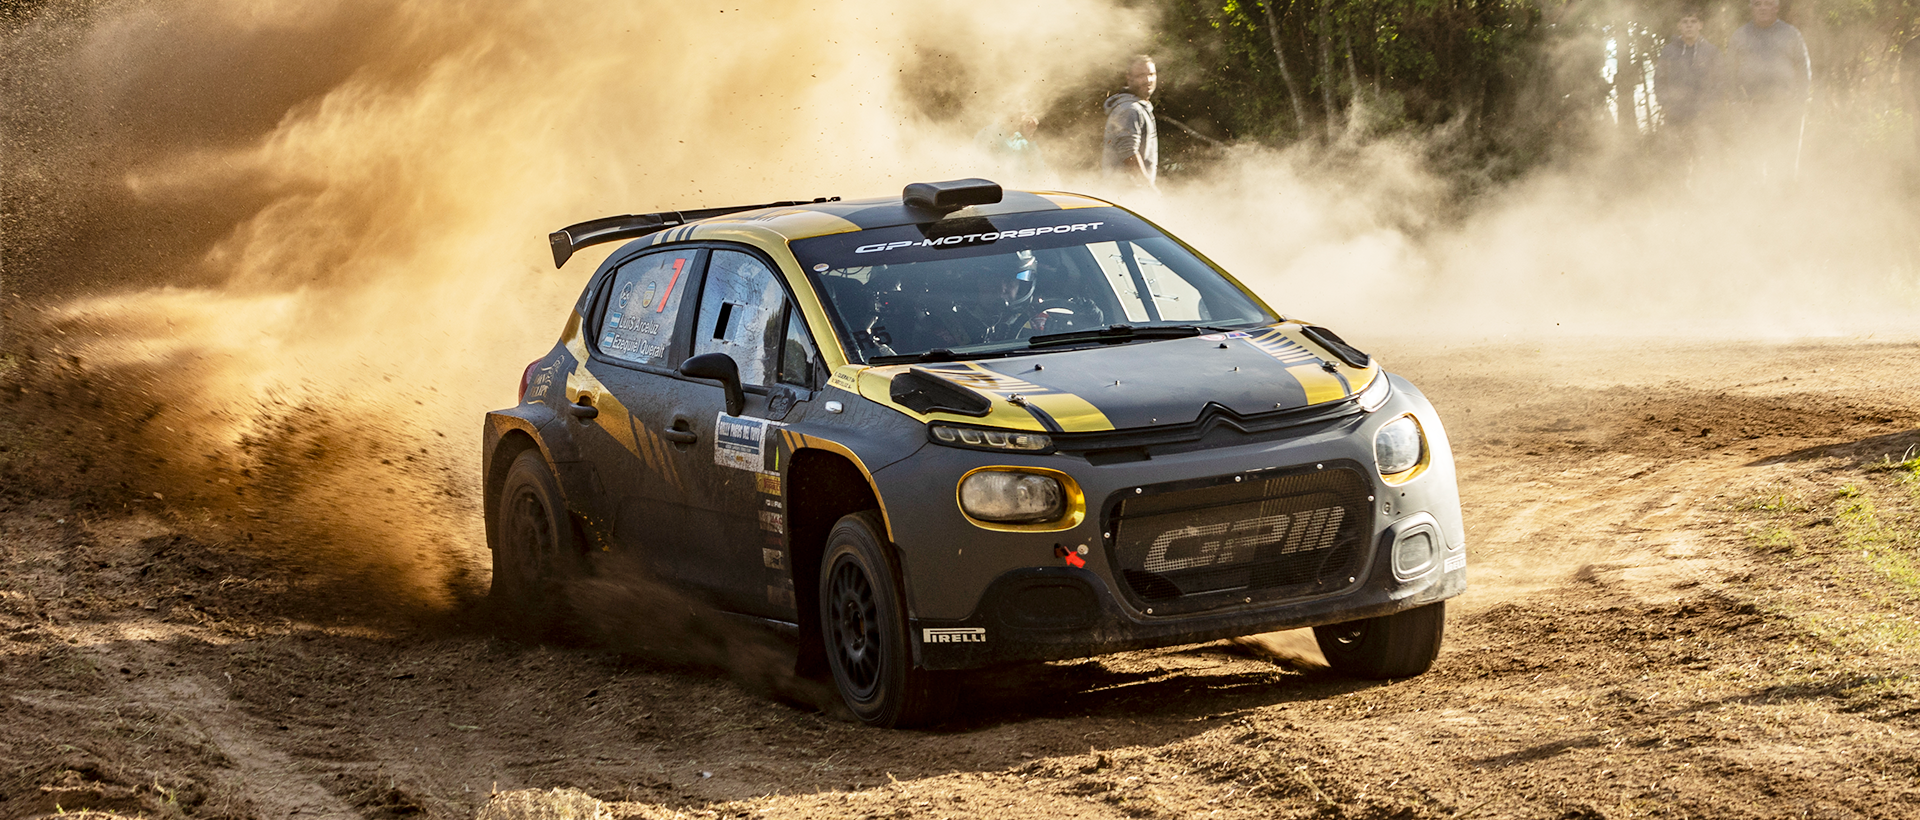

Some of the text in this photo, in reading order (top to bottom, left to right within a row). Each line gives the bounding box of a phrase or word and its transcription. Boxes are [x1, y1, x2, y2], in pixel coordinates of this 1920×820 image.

[855, 222, 1104, 253] GP-MOTORSPORT
[612, 334, 641, 354] Ezequiel
[923, 627, 986, 643] PIRELLI
